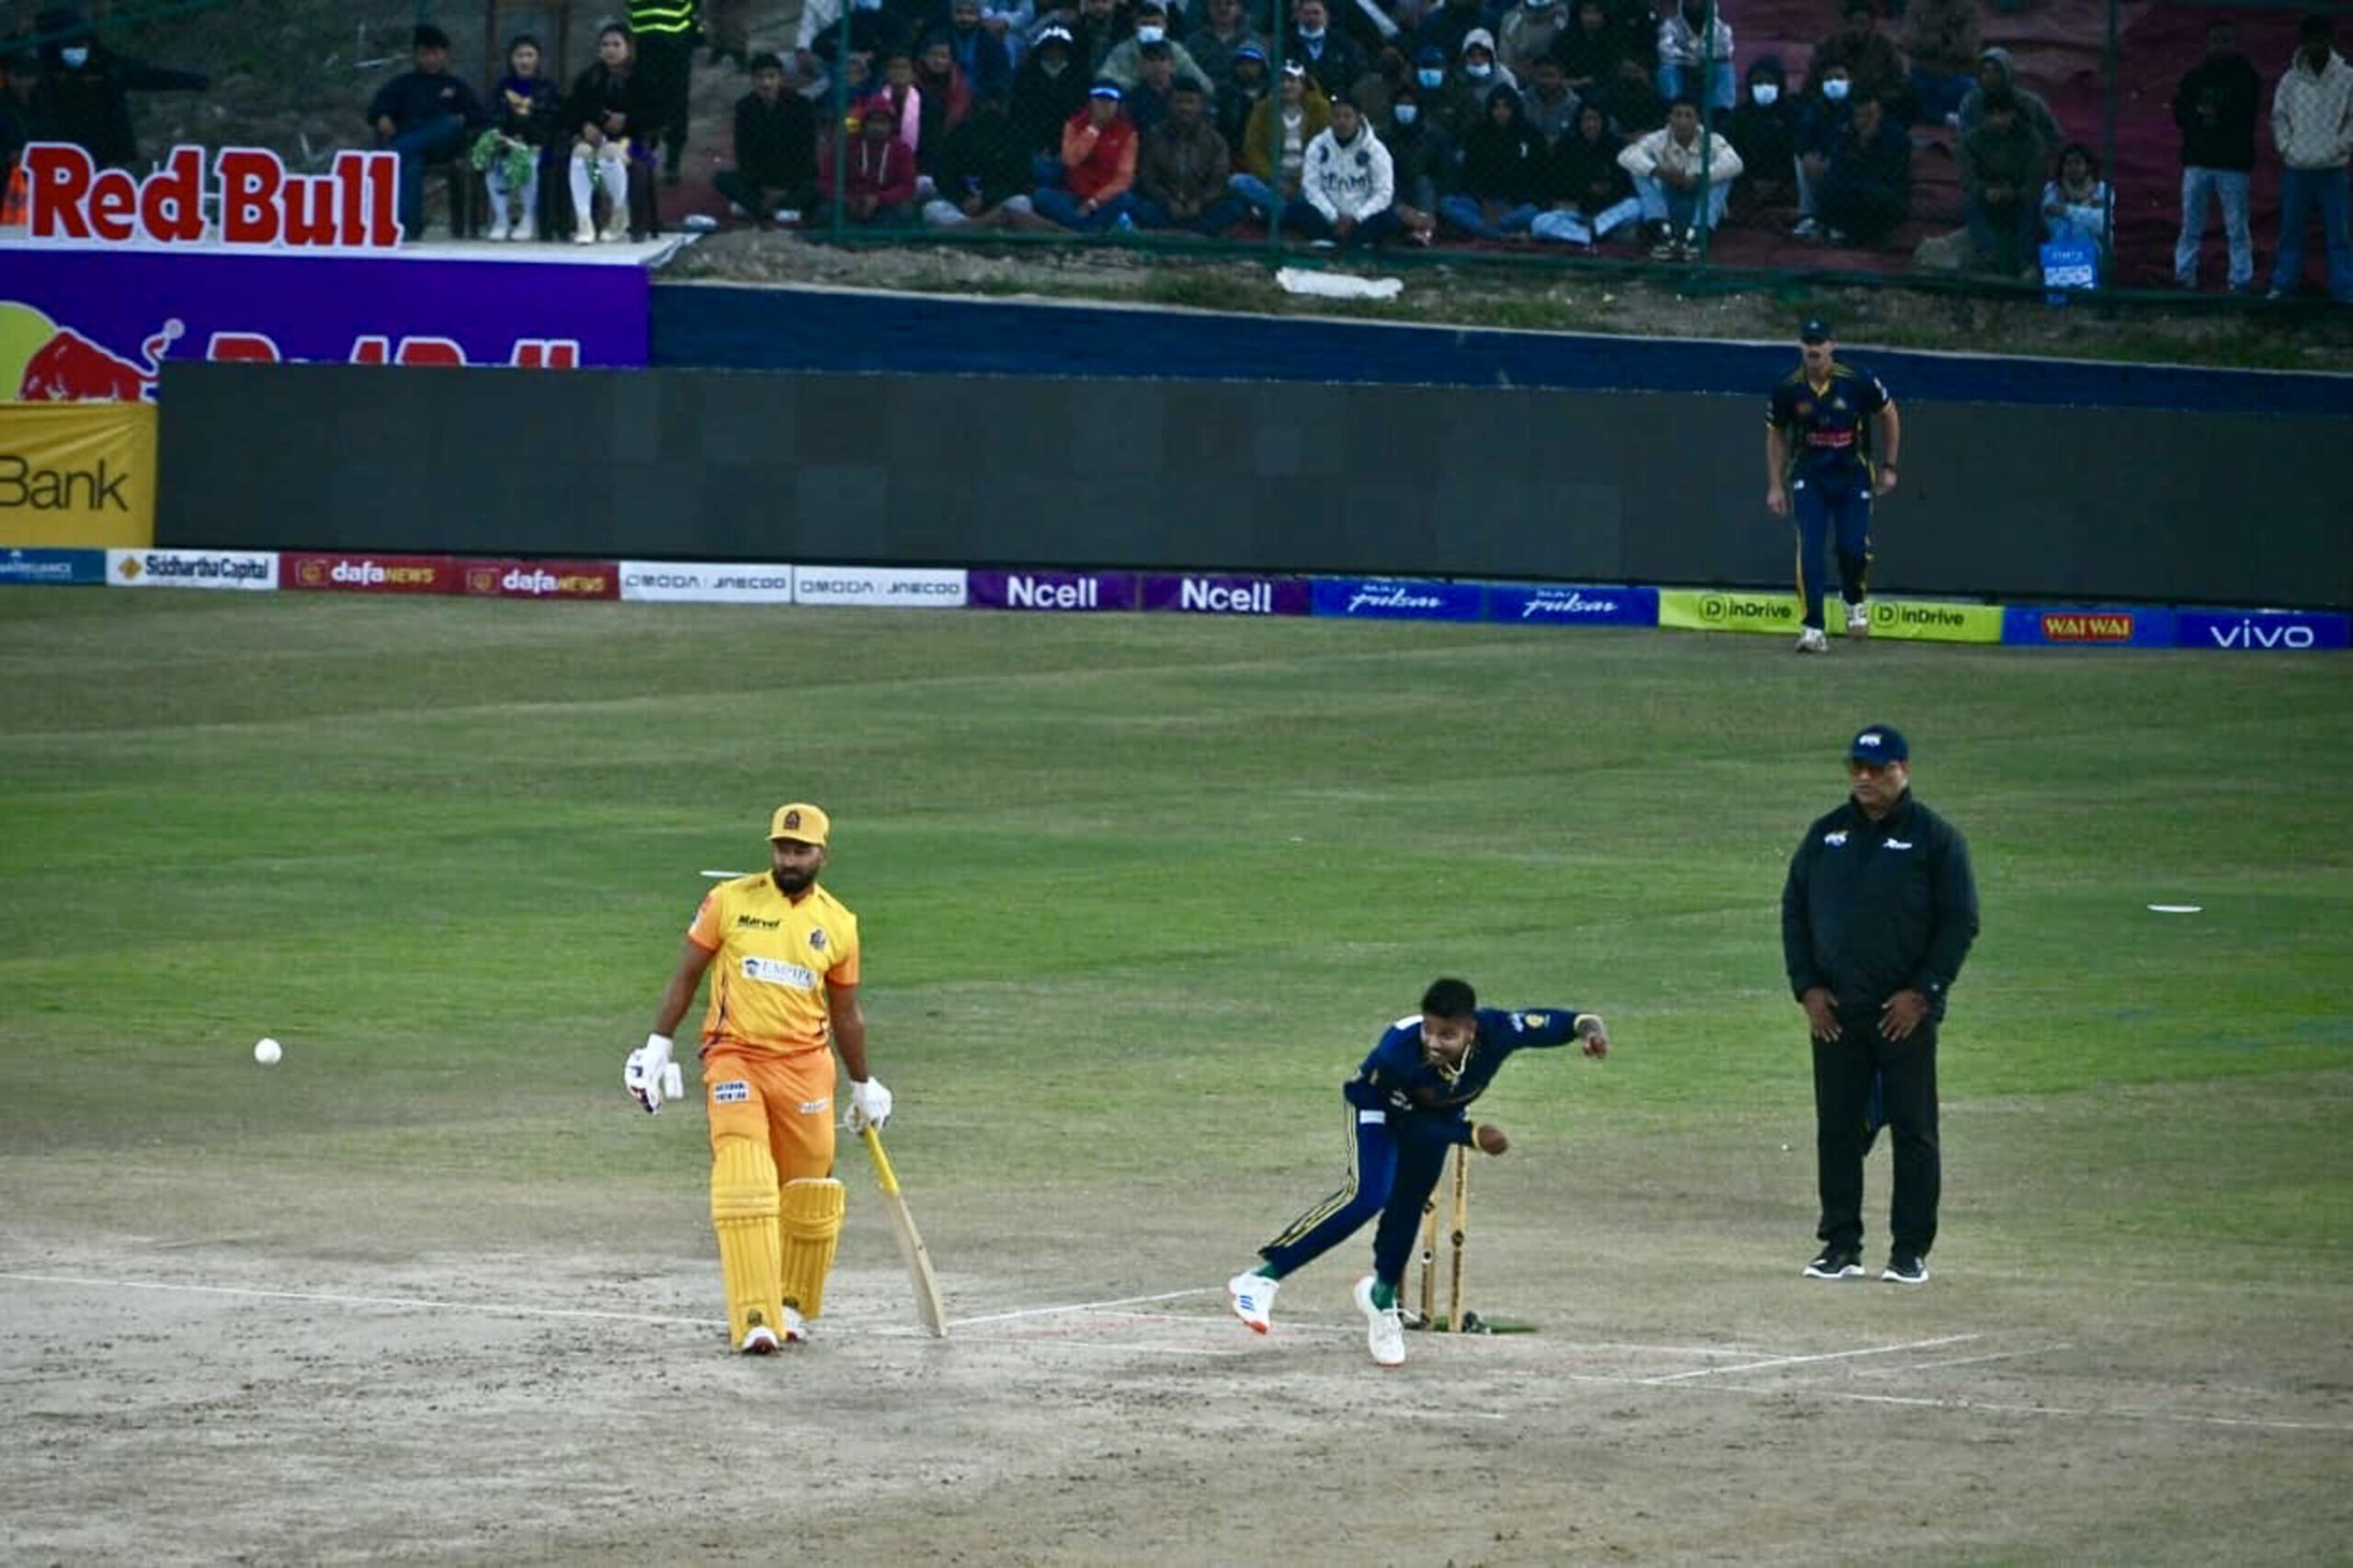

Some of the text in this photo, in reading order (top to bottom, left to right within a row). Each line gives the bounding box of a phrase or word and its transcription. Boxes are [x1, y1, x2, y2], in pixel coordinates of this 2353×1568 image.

[26, 143, 403, 248] Red Bull
[0, 455, 130, 512] Bank
[145, 555, 268, 582] Siddhartha Capital
[1007, 575, 1098, 608] Ncell
[1181, 578, 1272, 613] Ncell
[1728, 597, 1791, 619] inDrive
[1901, 604, 1965, 627] inDrive
[2045, 618, 2131, 637] WAI WAI
[2209, 618, 2315, 648] vivo
